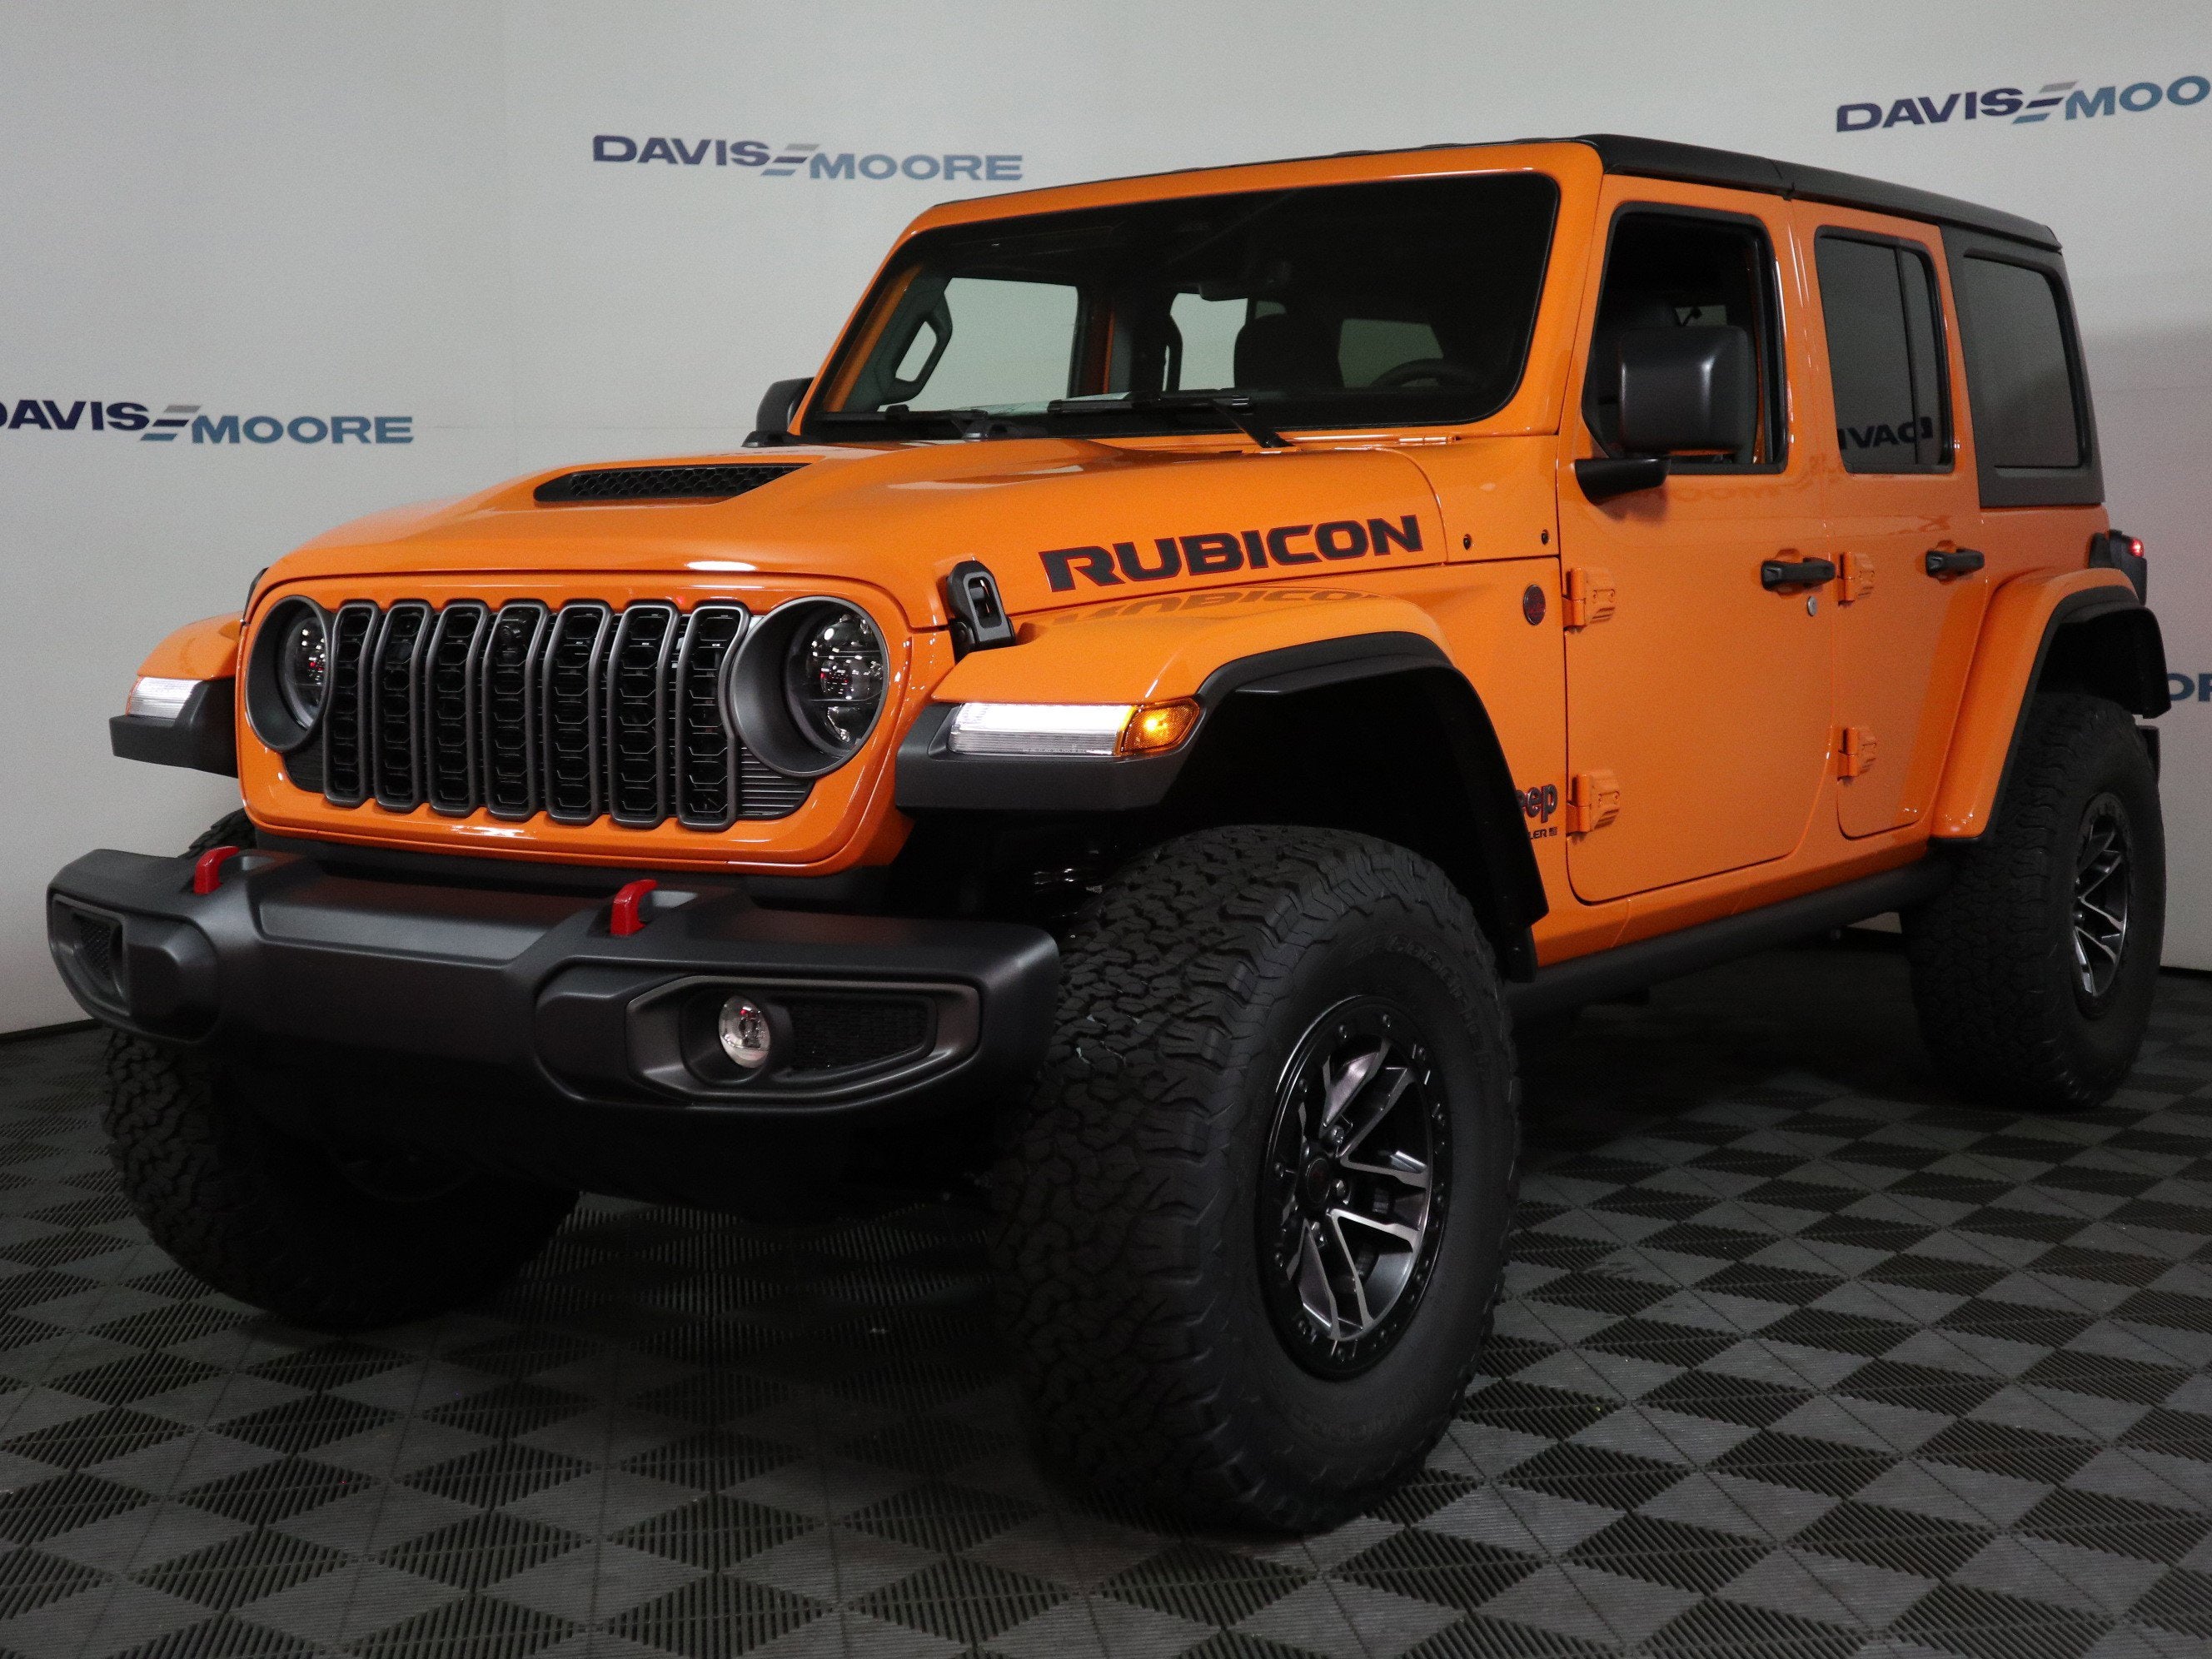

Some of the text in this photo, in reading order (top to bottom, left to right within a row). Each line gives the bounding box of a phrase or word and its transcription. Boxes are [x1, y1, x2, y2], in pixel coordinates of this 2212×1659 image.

[1836, 87, 2024, 133] DAVIS
[592, 134, 1023, 181] DAVIS MOORE
[0, 399, 414, 445] AVIS MOORE
[1039, 515, 1423, 592] RUBICON
